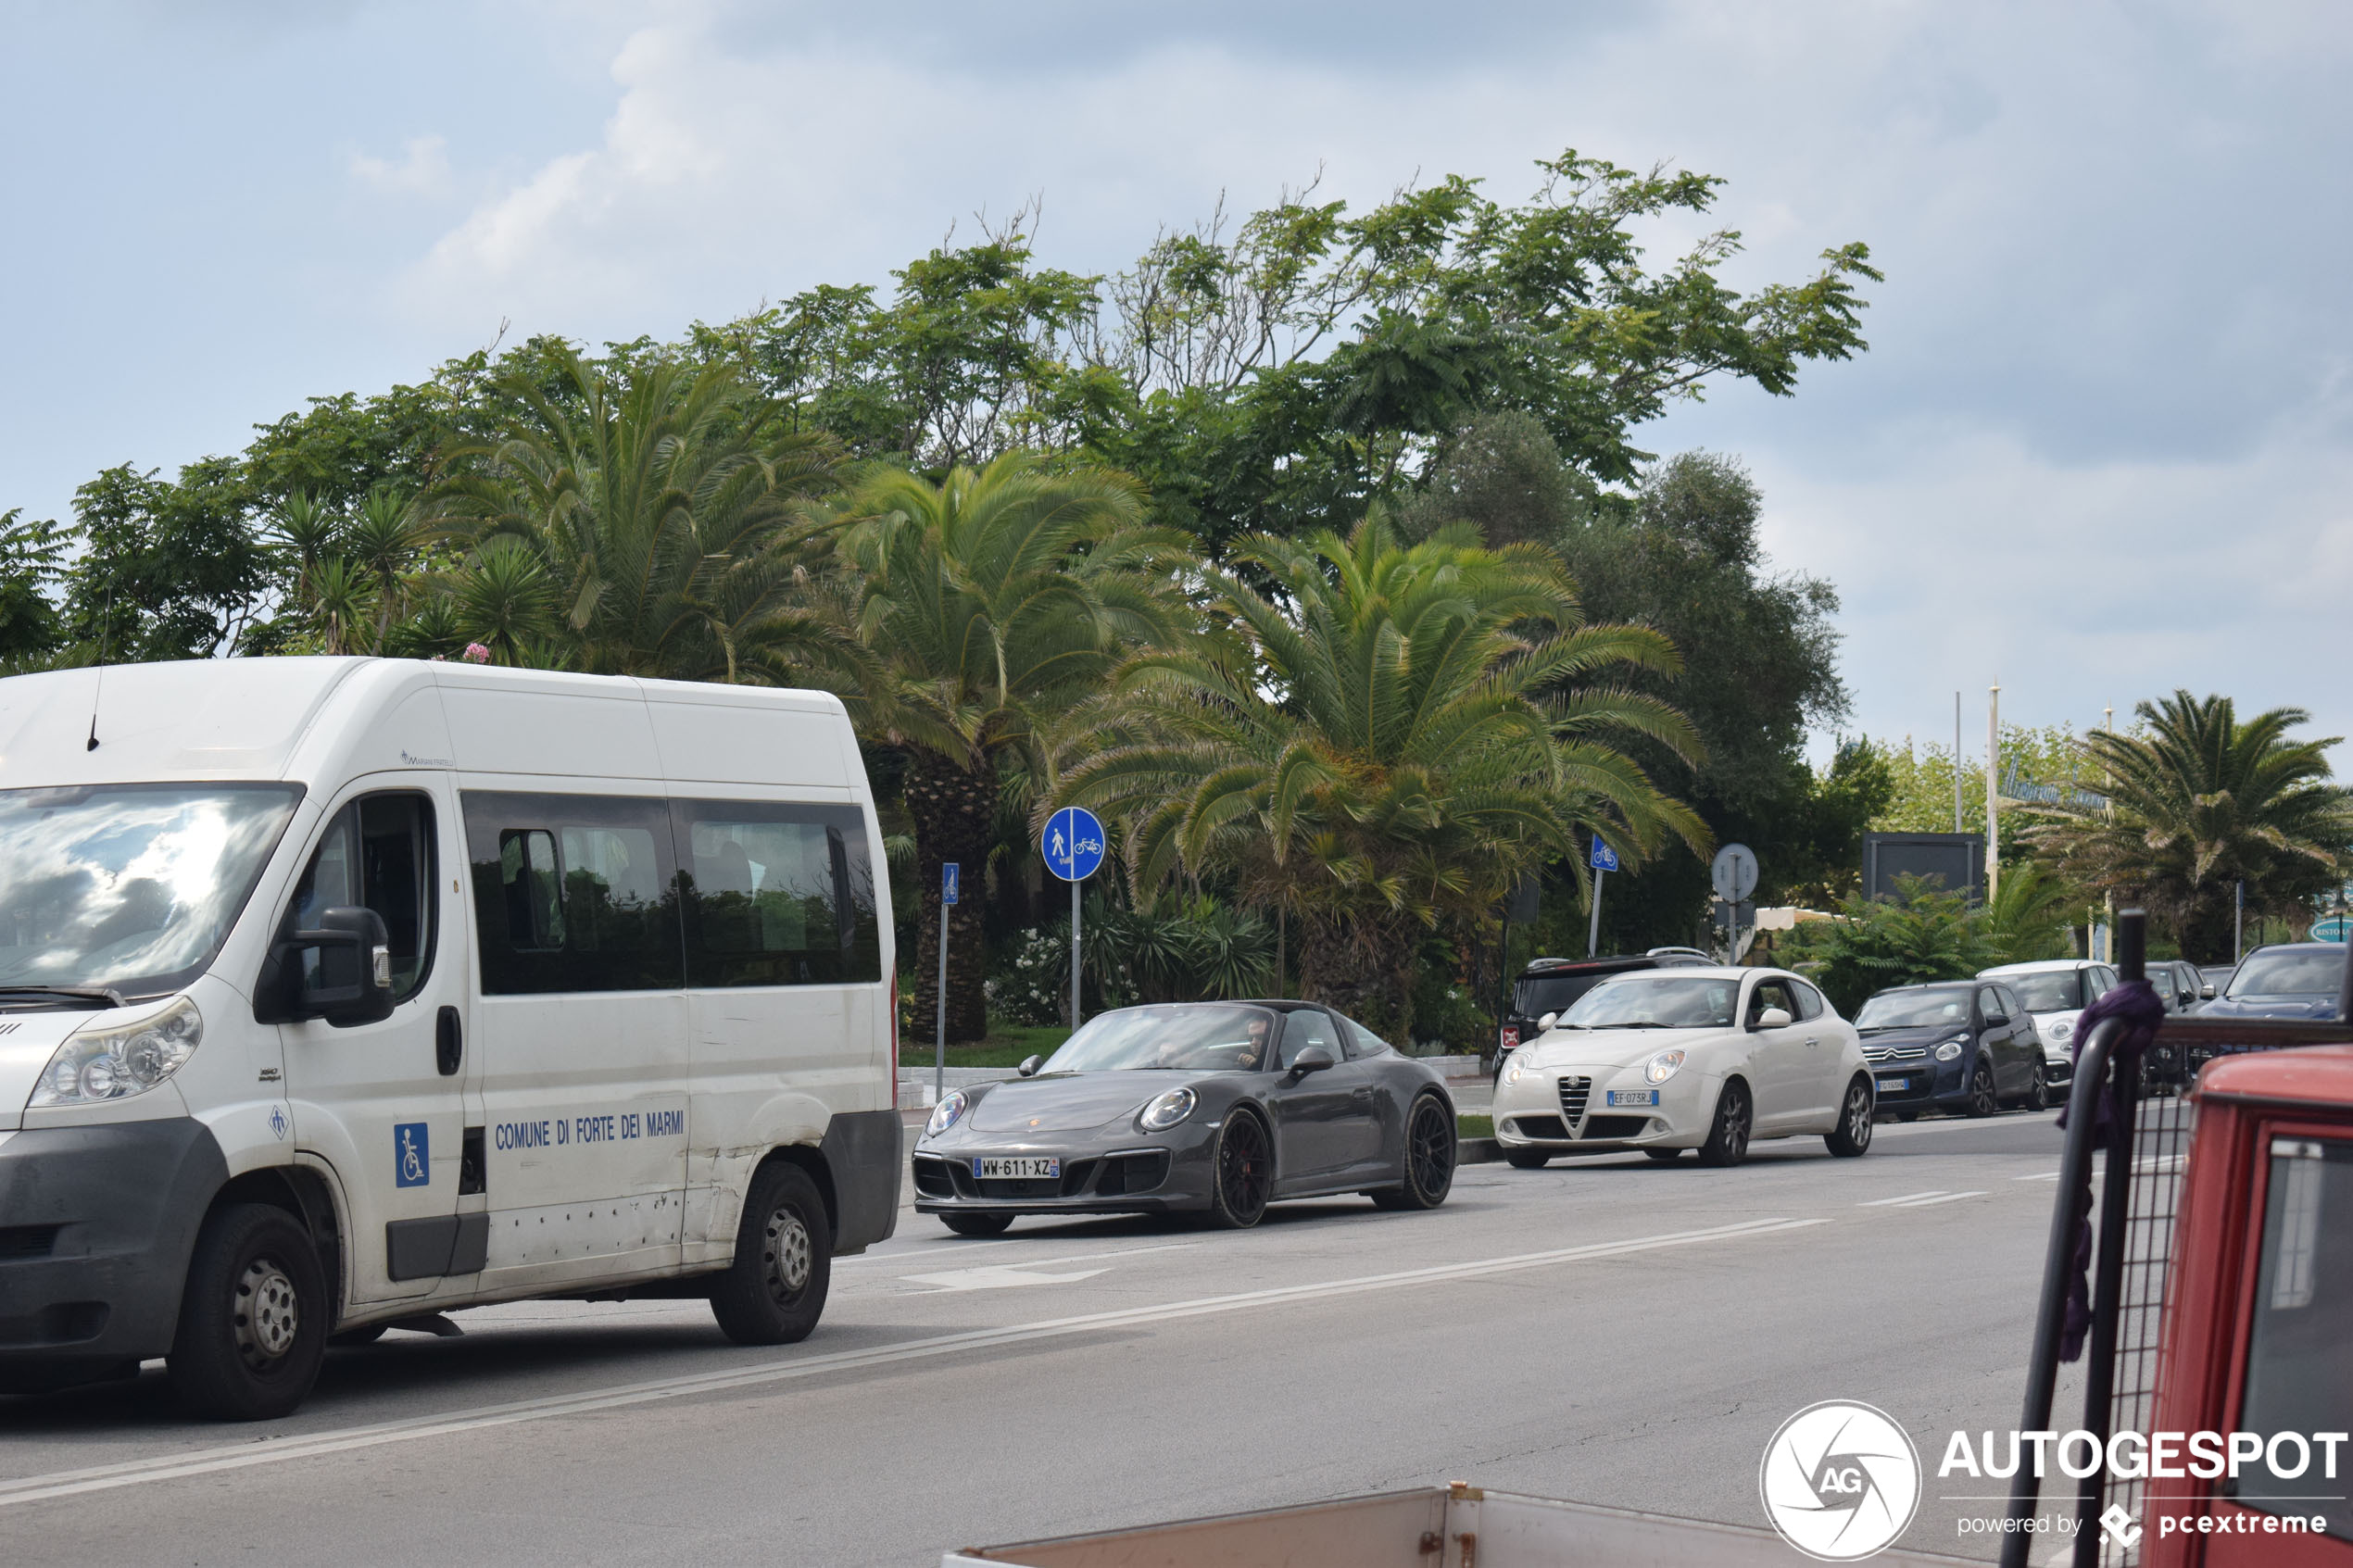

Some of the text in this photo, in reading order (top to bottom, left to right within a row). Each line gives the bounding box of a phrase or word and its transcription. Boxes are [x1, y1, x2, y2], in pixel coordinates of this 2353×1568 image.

[496, 1110, 684, 1150] COMUNE DI FORTE DEI MARMI
